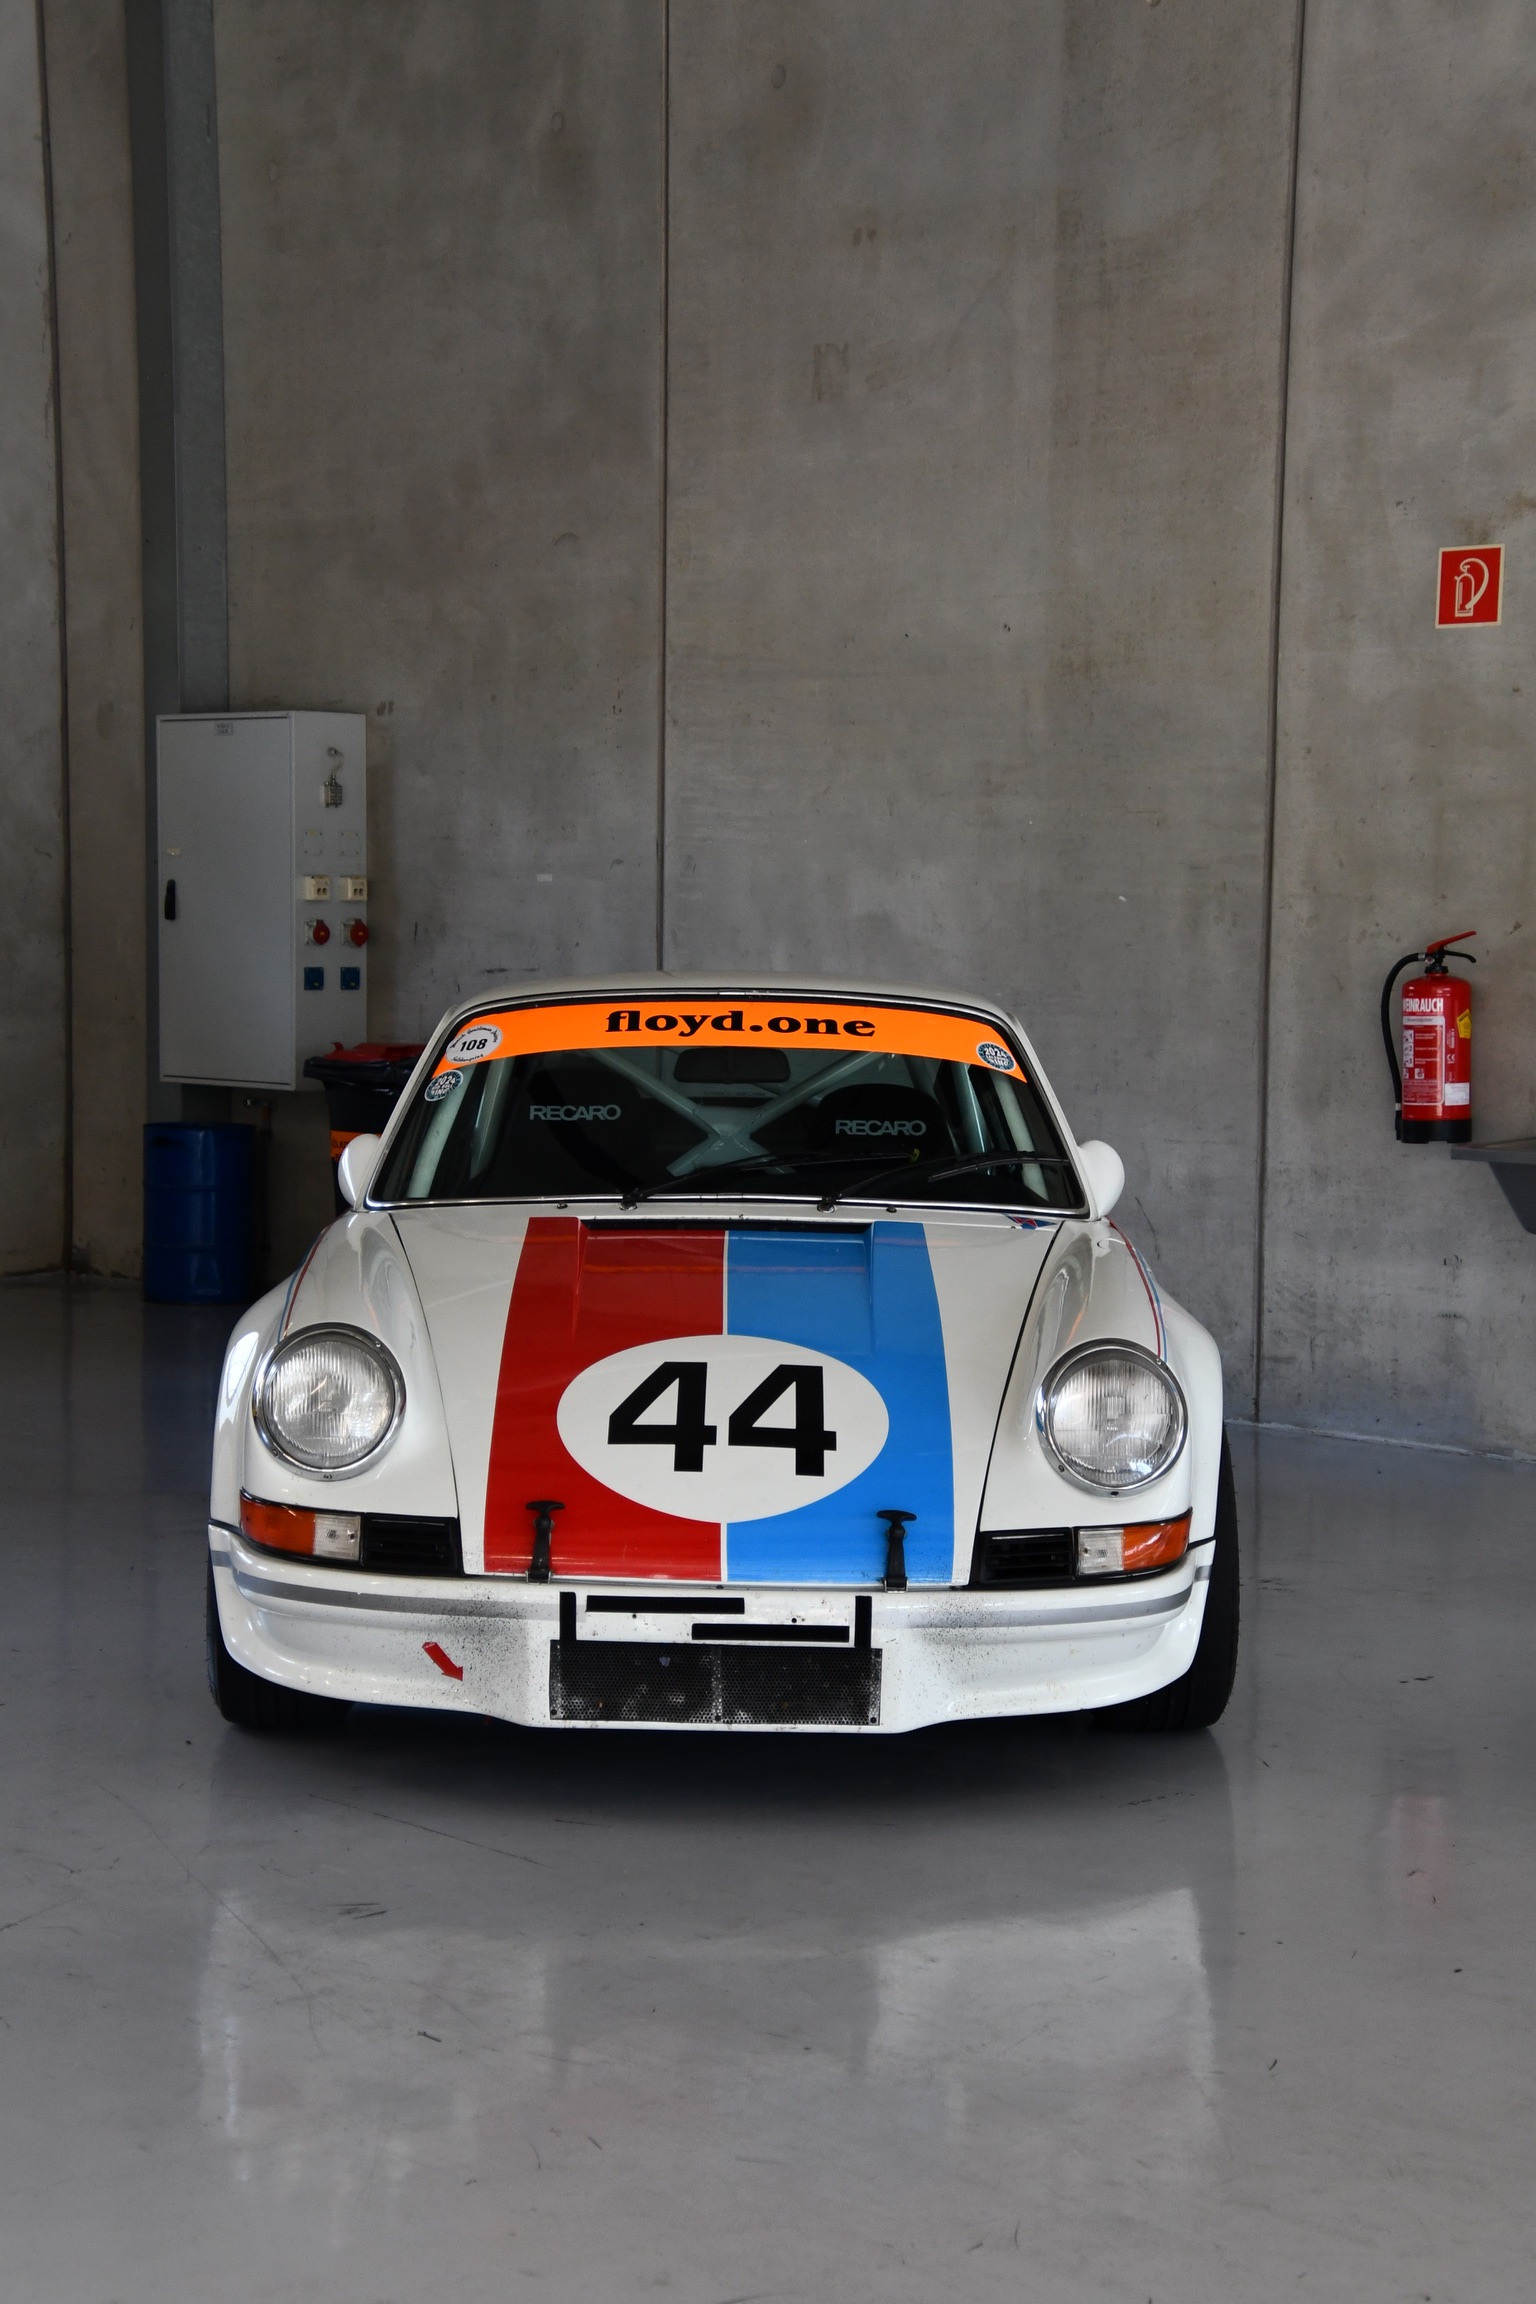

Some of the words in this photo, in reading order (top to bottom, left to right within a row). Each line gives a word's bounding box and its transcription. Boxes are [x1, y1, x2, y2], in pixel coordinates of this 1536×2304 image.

[605, 1010, 875, 1037] floyd.one
[460, 1038, 488, 1052] 108
[984, 1047, 1007, 1058] 2024
[435, 1075, 456, 1087] 2024
[529, 1104, 621, 1121] RECARO
[835, 1120, 926, 1136] RECARO
[608, 1363, 836, 1476] 44
